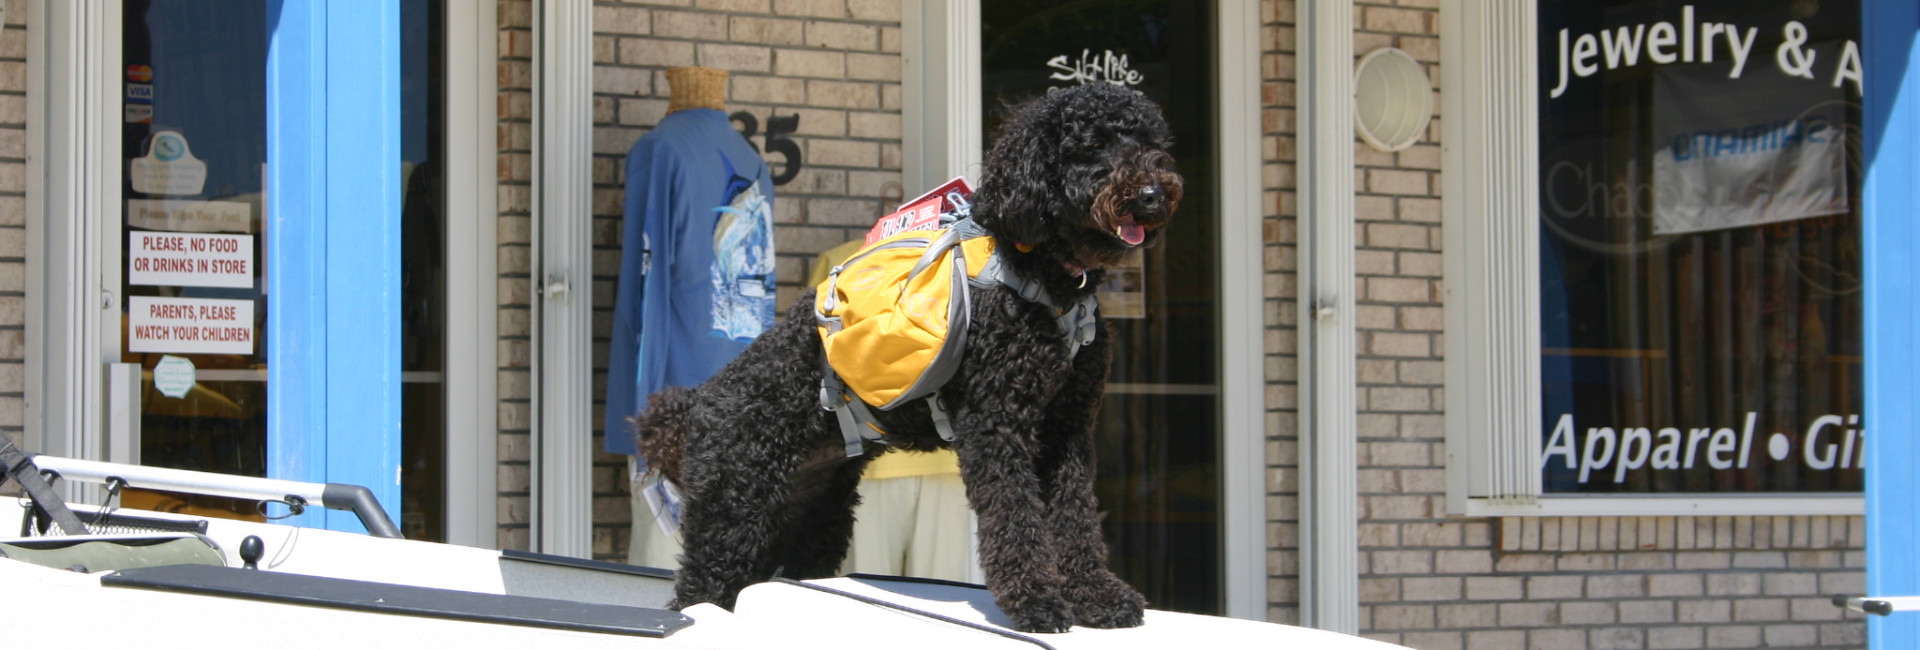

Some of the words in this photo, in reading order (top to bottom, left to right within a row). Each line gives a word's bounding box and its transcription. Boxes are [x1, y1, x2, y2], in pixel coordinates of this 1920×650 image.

[1550, 5, 1758, 99] Jewelry
[1777, 21, 1816, 79] &
[130, 87, 151, 96] VISA
[143, 236, 187, 254] PLEASE,
[190, 237, 206, 252] NO
[209, 238, 238, 253] FOOD
[134, 258, 150, 272] OR
[153, 258, 194, 273] DRINKS
[197, 259, 208, 273] IN
[212, 260, 246, 274] STORE
[150, 304, 197, 322] PARENTS,
[200, 306, 236, 320] PLEASE
[135, 325, 169, 340] WATCH
[173, 327, 199, 341] YOUR
[202, 328, 250, 342] CHILDREN
[1541, 411, 1757, 484] Apparel
